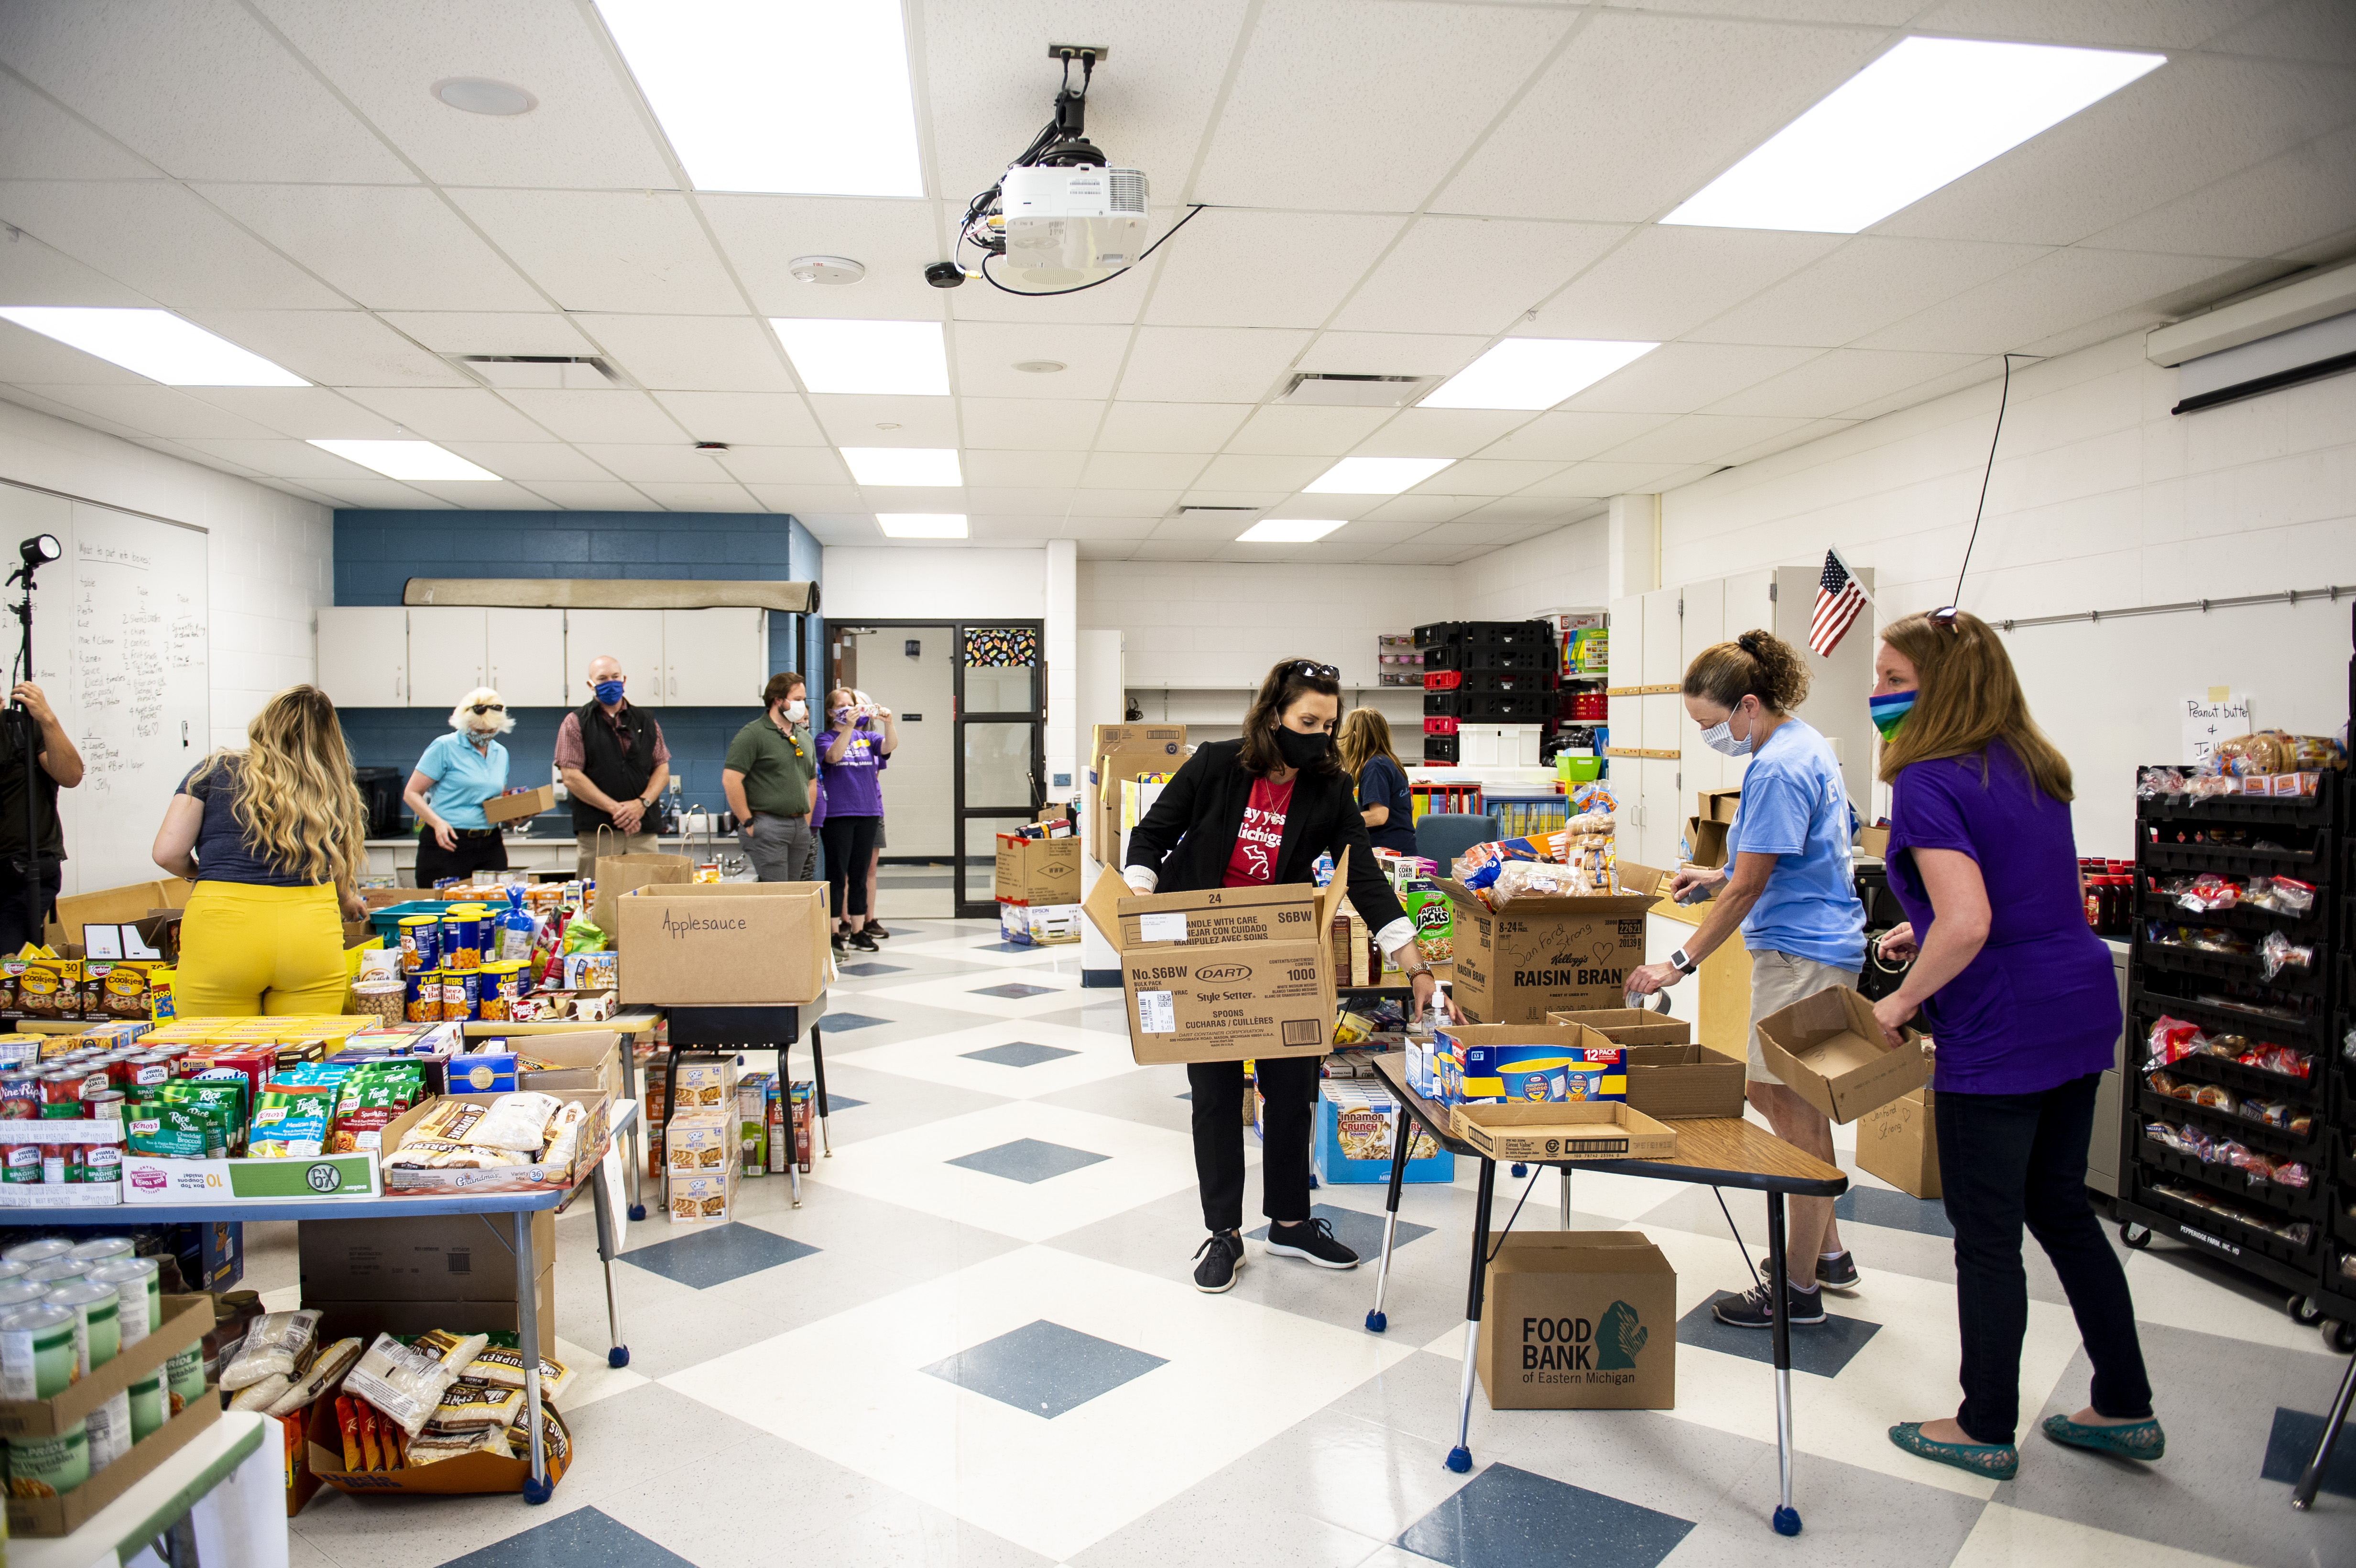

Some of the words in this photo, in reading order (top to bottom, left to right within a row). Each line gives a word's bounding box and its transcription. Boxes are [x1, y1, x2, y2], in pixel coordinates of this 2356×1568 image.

[97, 545, 102, 555] to
[106, 548, 115, 561] put
[2187, 700, 2220, 718] Peanut
[2223, 702, 2249, 718] butter
[1244, 807, 1262, 823] ay
[1209, 893, 1222, 904] 24
[1278, 910, 1312, 924] S6BW
[1421, 906, 1443, 915] APPLE
[662, 908, 747, 939] Applesauce
[1186, 919, 1212, 929] ANDLE
[1213, 917, 1234, 926] WITH
[1237, 916, 1258, 925] CARE
[1416, 912, 1450, 931] JACKS
[1499, 922, 1518, 933] 8-24
[1619, 923, 1641, 933] 22621
[1187, 929, 1211, 937] NEJAR
[1212, 926, 1229, 936] CON
[1231, 924, 1267, 934] CUIDADO
[1174, 936, 1220, 947] MANIPULEZ
[1221, 935, 1242, 943] AVEC
[1243, 933, 1268, 941] SOINS
[1556, 924, 1592, 953] Strong
[1619, 938, 1637, 947] 20139
[1637, 938, 1642, 947] B
[1508, 944, 1538, 968] San
[1539, 924, 1566, 949] Ford
[1550, 952, 1589, 967] Kellogg's
[4, 964, 25, 972] Keebler
[65, 963, 77, 972] 30
[1132, 969, 1151, 980] No.
[1152, 966, 1188, 979] S6BW
[1202, 967, 1245, 979] DART
[1287, 968, 1316, 981] 1000
[1457, 963, 1472, 979] RAISIN
[1472, 969, 1485, 985] BRAN
[23, 975, 56, 983] Cookies
[1514, 969, 1571, 987] RAISIN
[1578, 968, 1622, 985] BRAN
[153, 990, 171, 999] ZOO
[1197, 991, 1221, 1004] Style
[1222, 991, 1253, 1001] Setter
[512, 1002, 535, 1013] Snack
[518, 1009, 536, 1019] pack
[1212, 1009, 1244, 1018] SPOONS
[1186, 1019, 1226, 1029] CUCHARAS
[1233, 1015, 1274, 1026] CUILLÈRES
[1584, 1049, 1599, 1061] 12
[200, 1090, 222, 1100] Rice
[296, 1097, 319, 1111] Fiesta
[180, 1122, 199, 1132] Sides
[448, 1114, 477, 1141] SUPREME
[1878, 1122, 1902, 1140] Strong
[177, 1137, 201, 1145] Broccoli
[206, 1174, 223, 1187] 10
[456, 1173, 499, 1187] Grandma's
[2180, 1225, 2207, 1241] PEPPERIDGE
[2207, 1236, 2221, 1249] FARM,
[2232, 1246, 2240, 1255] HD
[203, 1271, 212, 1287] 18
[1523, 1317, 1592, 1343] FOOD
[1523, 1344, 1592, 1371] BANK
[1522, 1371, 1534, 1383] of
[1538, 1372, 1582, 1384] Eastern
[1586, 1372, 1635, 1385] Michigan
